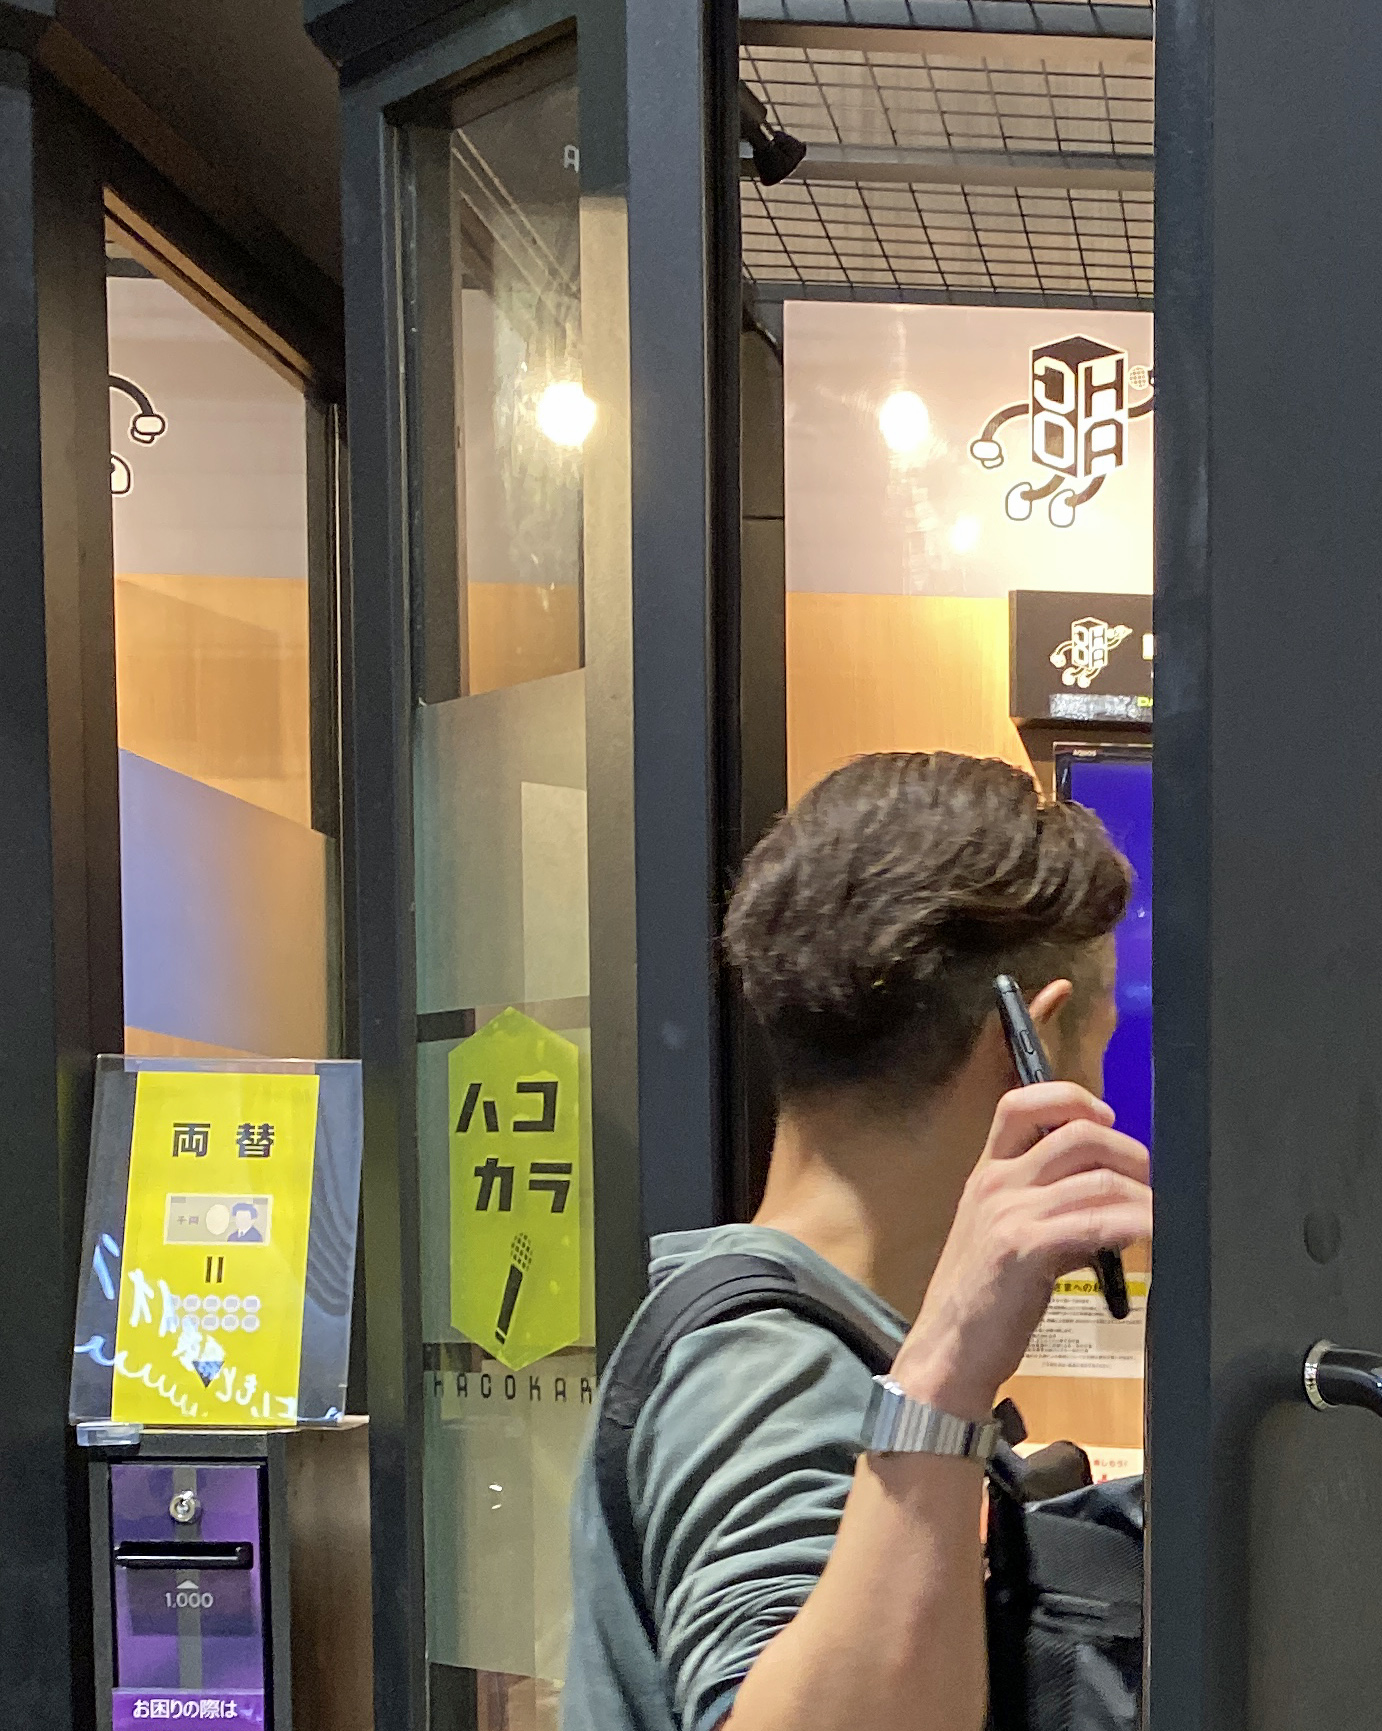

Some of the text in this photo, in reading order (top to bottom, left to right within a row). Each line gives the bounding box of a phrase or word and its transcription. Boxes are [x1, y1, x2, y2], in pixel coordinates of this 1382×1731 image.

[455, 1081, 559, 1133] ハコ
[172, 1122, 275, 1158] 両替
[473, 1157, 573, 1213] カラ
[165, 1592, 214, 1609] 1,000
[133, 1699, 238, 1719] お困りの際は
